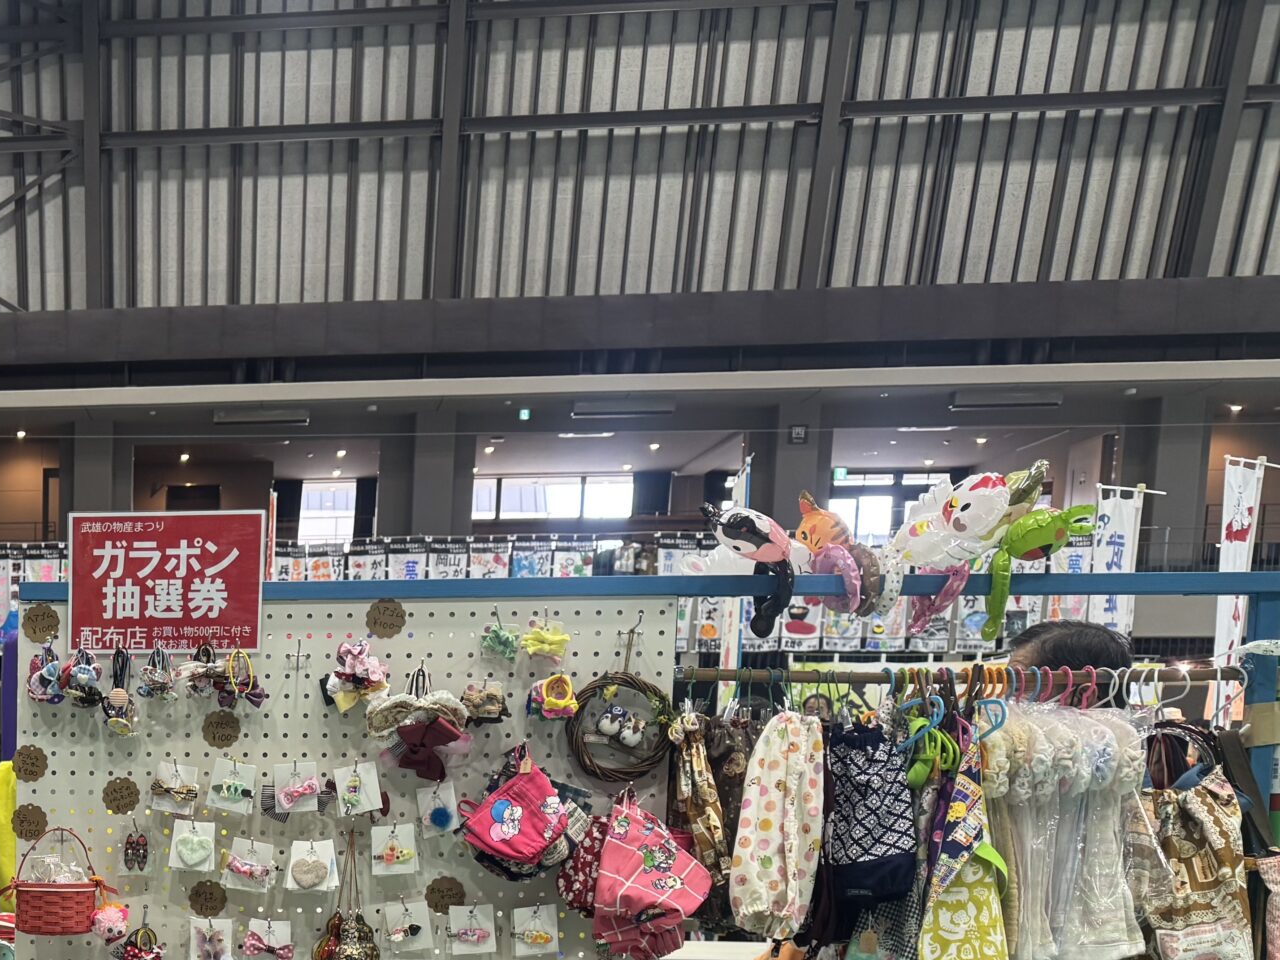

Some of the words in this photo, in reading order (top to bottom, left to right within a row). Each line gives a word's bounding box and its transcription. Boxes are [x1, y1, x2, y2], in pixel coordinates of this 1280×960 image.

[80, 521, 165, 533] 武雄の物産まつり
[92, 537, 240, 579] ガラポン
[102, 578, 228, 619] 抽選券
[80, 627, 148, 649] 配布店
[152, 626, 252, 637] お買い物500円に付き
